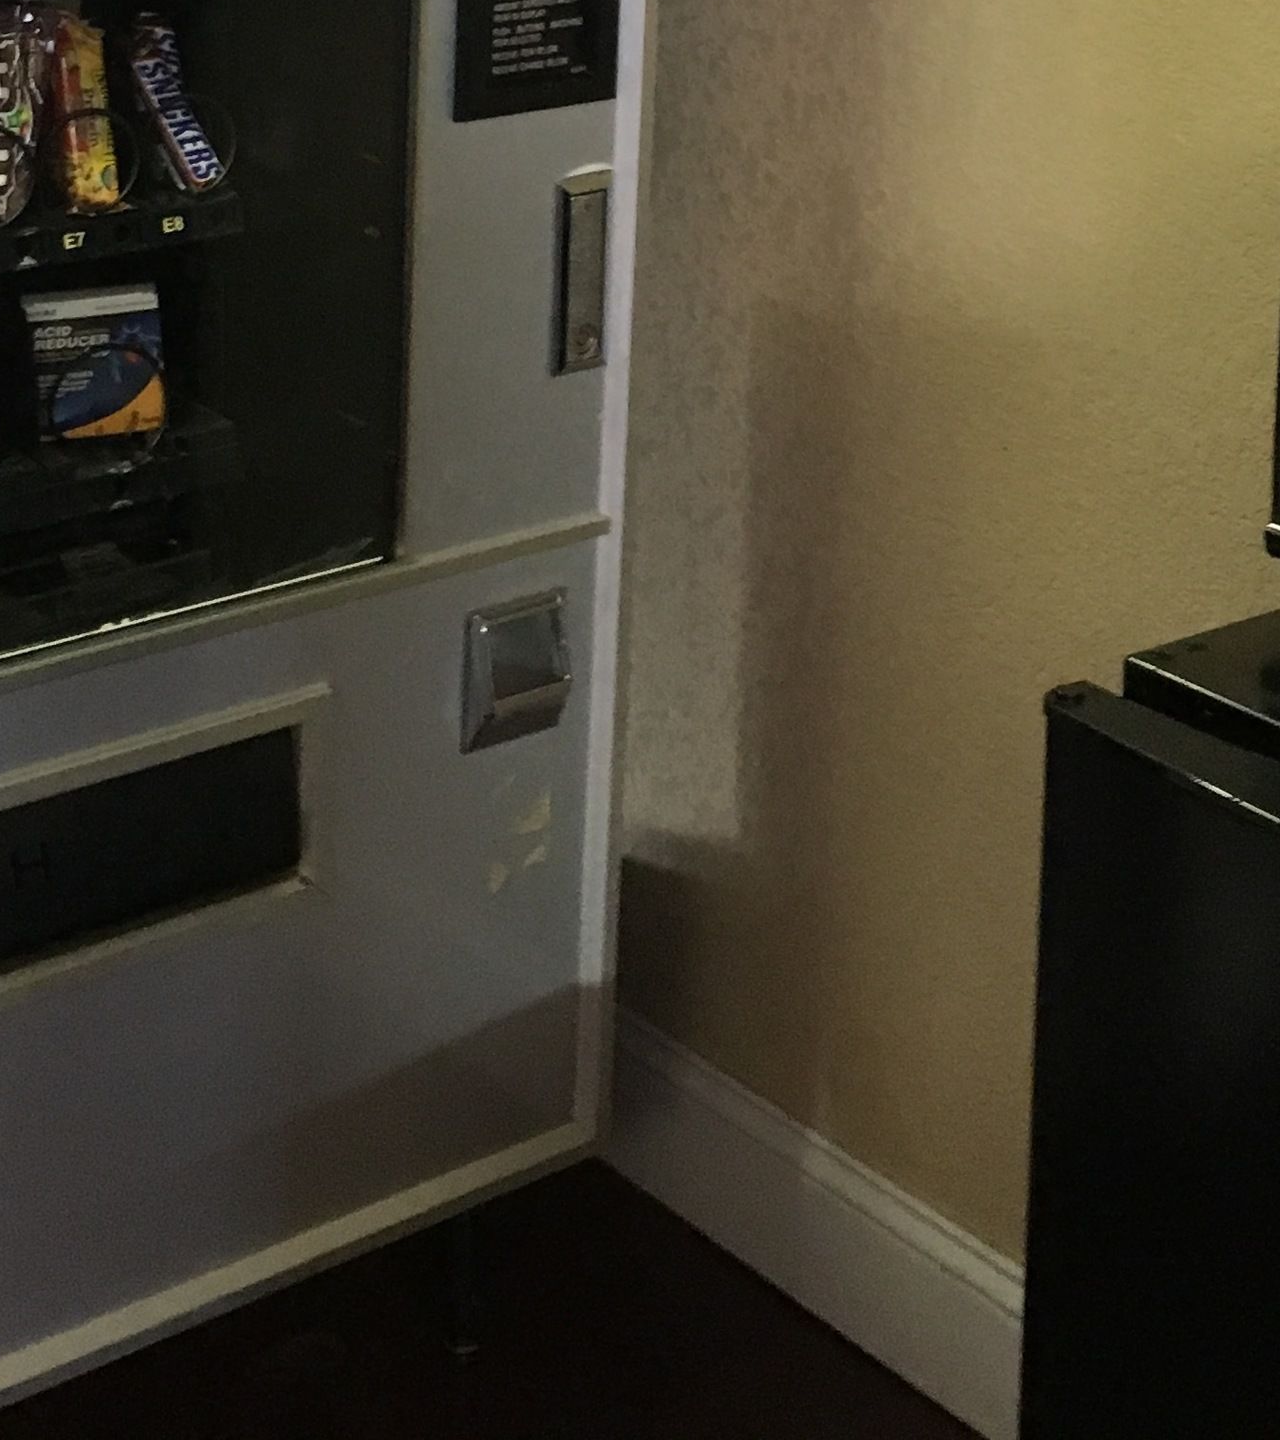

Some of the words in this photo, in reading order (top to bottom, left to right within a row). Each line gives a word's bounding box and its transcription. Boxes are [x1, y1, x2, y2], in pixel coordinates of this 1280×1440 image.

[136, 60, 220, 182] SNICKERS
[162, 216, 185, 234] E8
[63, 231, 86, 250] E7
[34, 325, 72, 339] ACID
[33, 333, 111, 352] REDUCER
